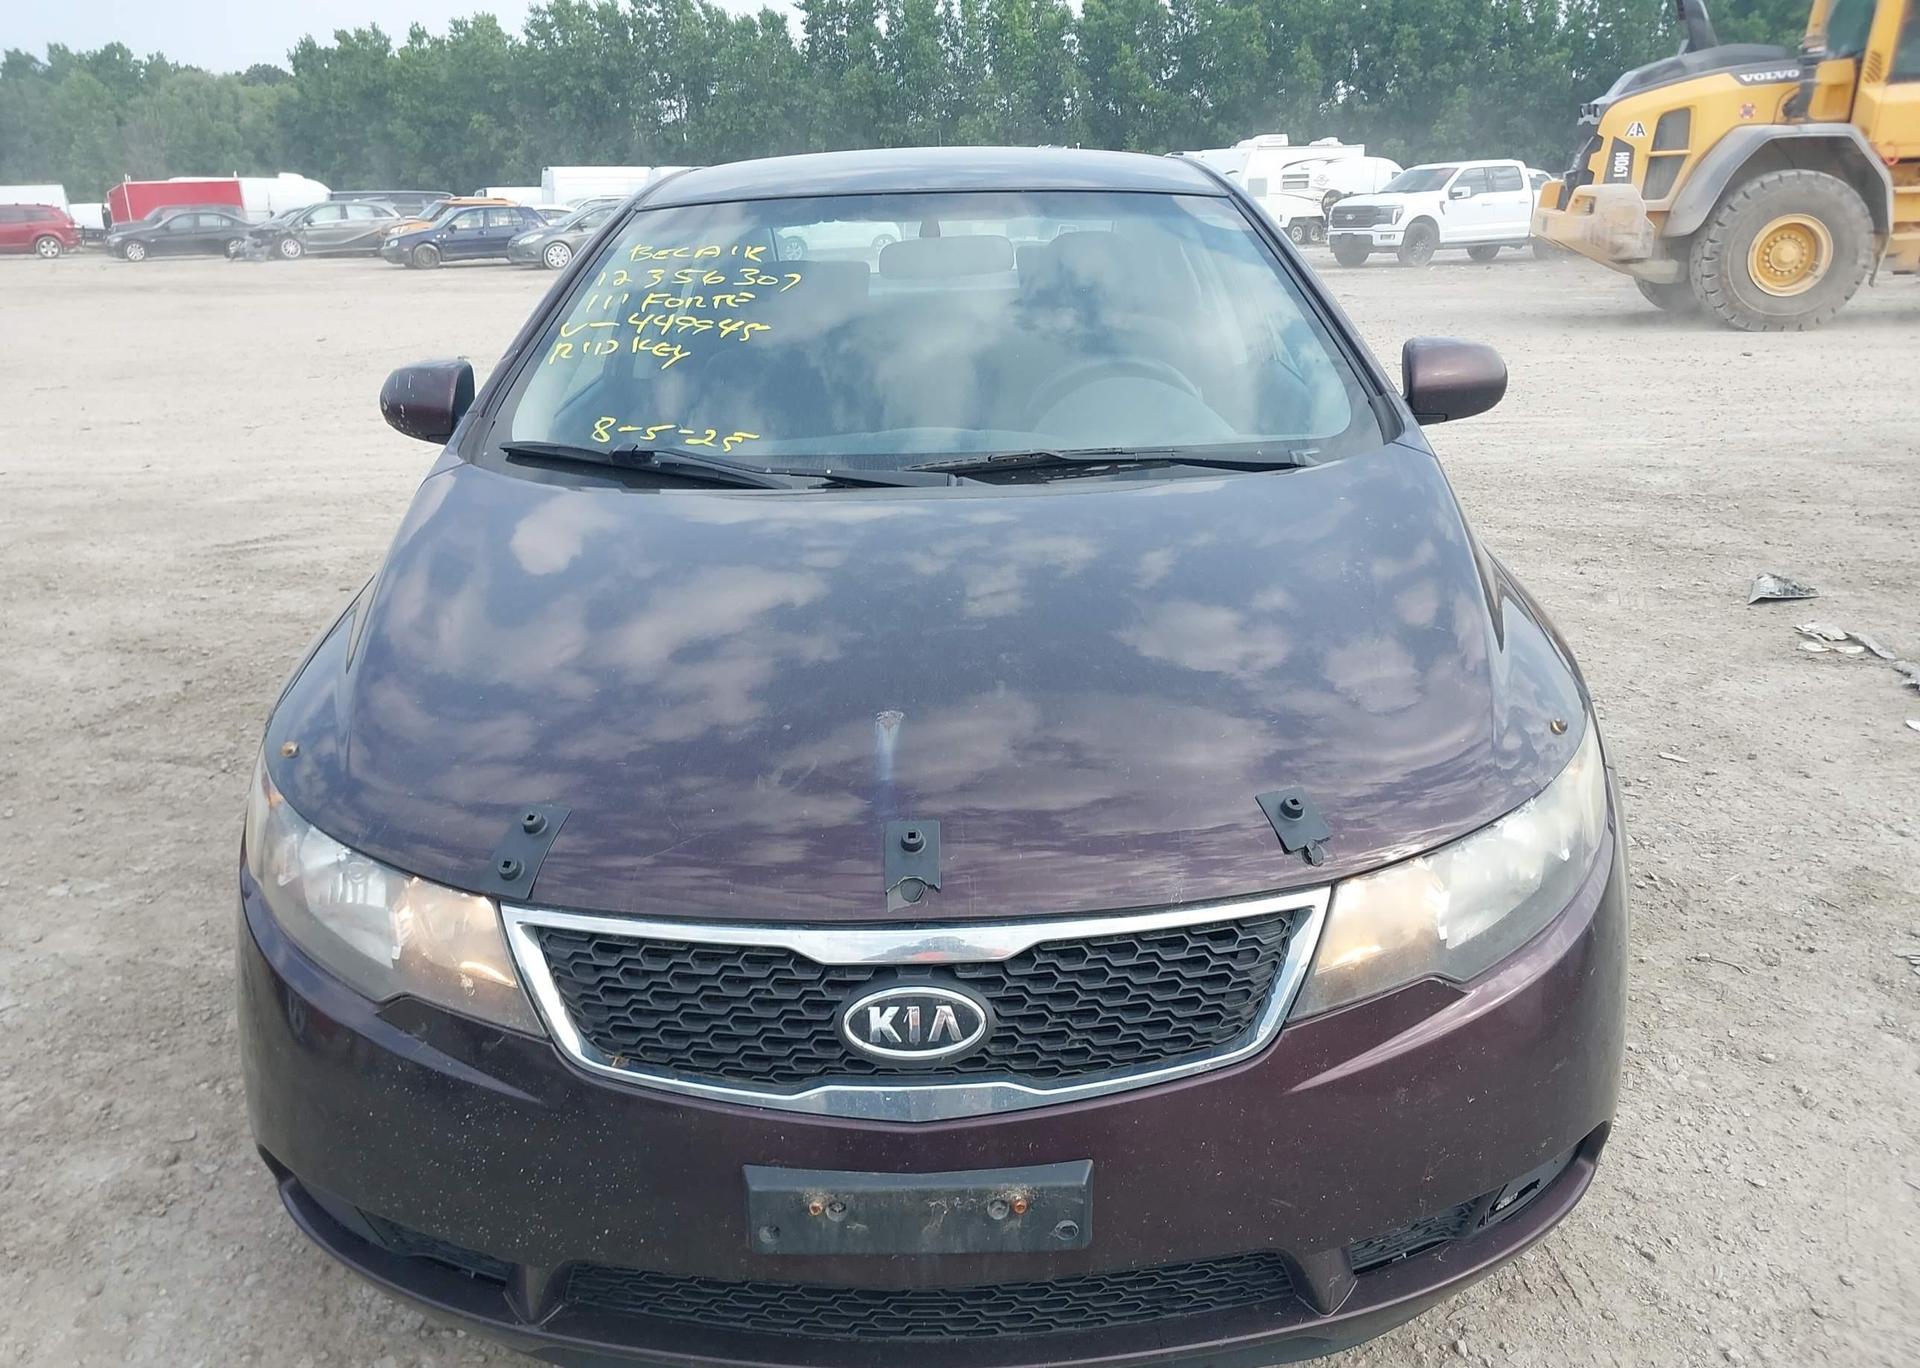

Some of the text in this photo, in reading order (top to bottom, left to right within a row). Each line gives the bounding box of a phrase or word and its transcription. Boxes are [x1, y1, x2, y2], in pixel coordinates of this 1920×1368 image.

[1739, 69, 1800, 82] VOLVO
[1613, 151, 1630, 178] L90H
[641, 291, 756, 312] FORTE
[631, 336, 692, 370] KEY
[867, 1004, 964, 1045] KIA
